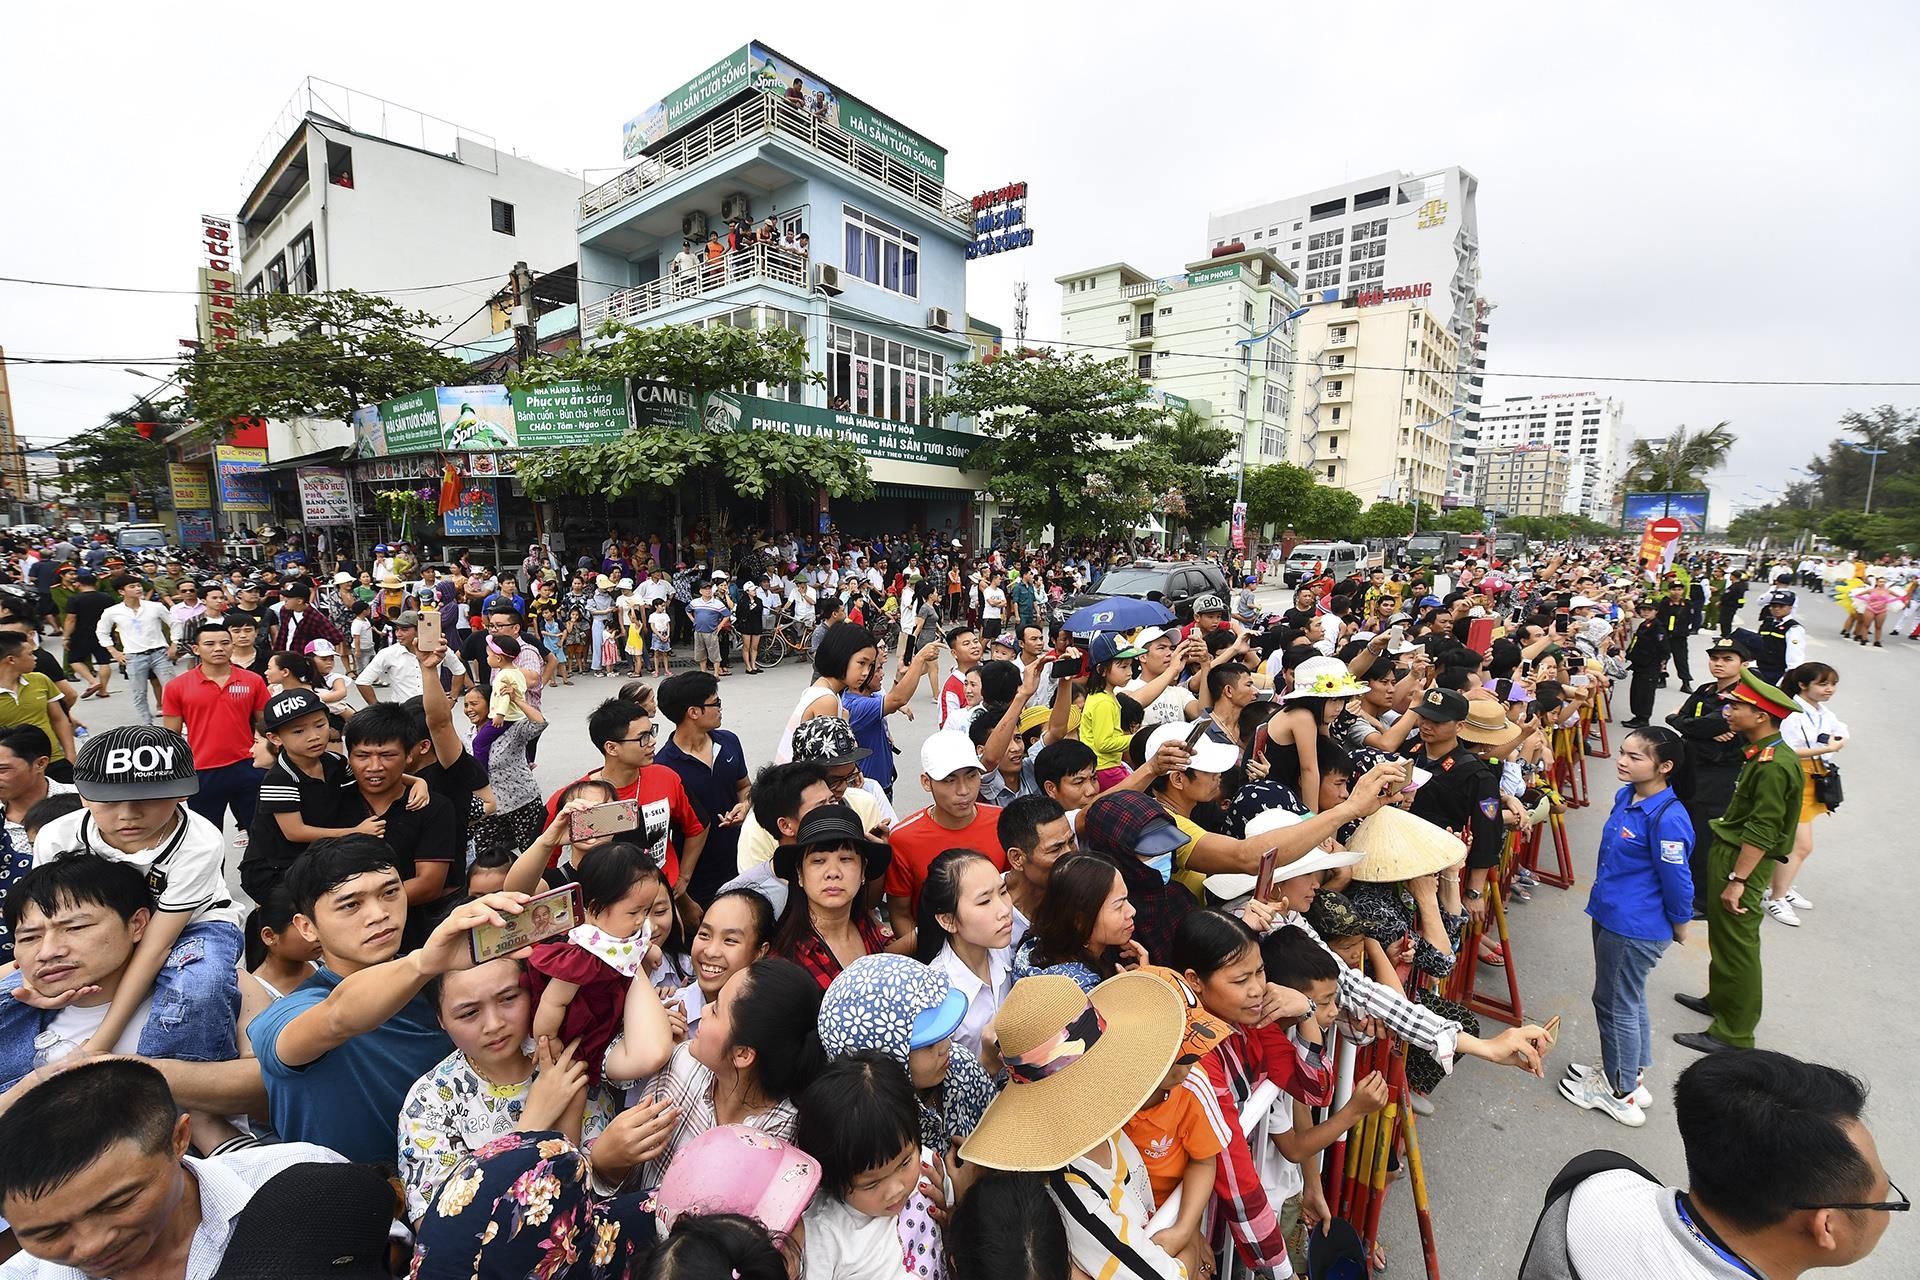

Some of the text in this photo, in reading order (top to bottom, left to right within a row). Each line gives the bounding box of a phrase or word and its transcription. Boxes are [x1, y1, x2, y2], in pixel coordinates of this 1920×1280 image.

[669, 100, 683, 120] HẢI
[683, 88, 700, 111] SẢN
[700, 78, 720, 101] TƯƠI
[722, 62, 746, 88] SỐNG
[756, 73, 783, 90] Sprite
[850, 115, 867, 135] HẢI
[869, 126, 888, 146] SẢN
[889, 137, 911, 158] TƯƠI
[913, 150, 937, 170] SỐNG
[1388, 282, 1432, 303] TRANG
[550, 385, 570, 395] HÀNG
[526, 392, 613, 410] Phục vụ ăn sáng
[385, 416, 396, 434] HẢI
[395, 414, 407, 432] SẢN
[420, 407, 437, 428] SỐNG
[517, 410, 536, 421] Bánh
[537, 408, 554, 420] cuốn
[560, 409, 574, 420] Bún
[575, 407, 588, 418] chả
[612, 407, 625, 416] cua
[835, 414, 855, 426] NHÀ
[856, 417, 880, 430] HÀNG
[898, 423, 915, 435] HÒA
[453, 421, 486, 445] Sprite
[529, 421, 552, 431] CHÁO
[579, 420, 600, 430] Ngao
[605, 419, 615, 427] Cá
[815, 424, 833, 440] ĂN
[879, 434, 897, 449] HẢI
[899, 437, 921, 452] SẢN
[923, 442, 944, 455] TƯƠI
[887, 451, 902, 459] THEO
[903, 452, 914, 460] YÊU
[105, 745, 174, 774] BOY
